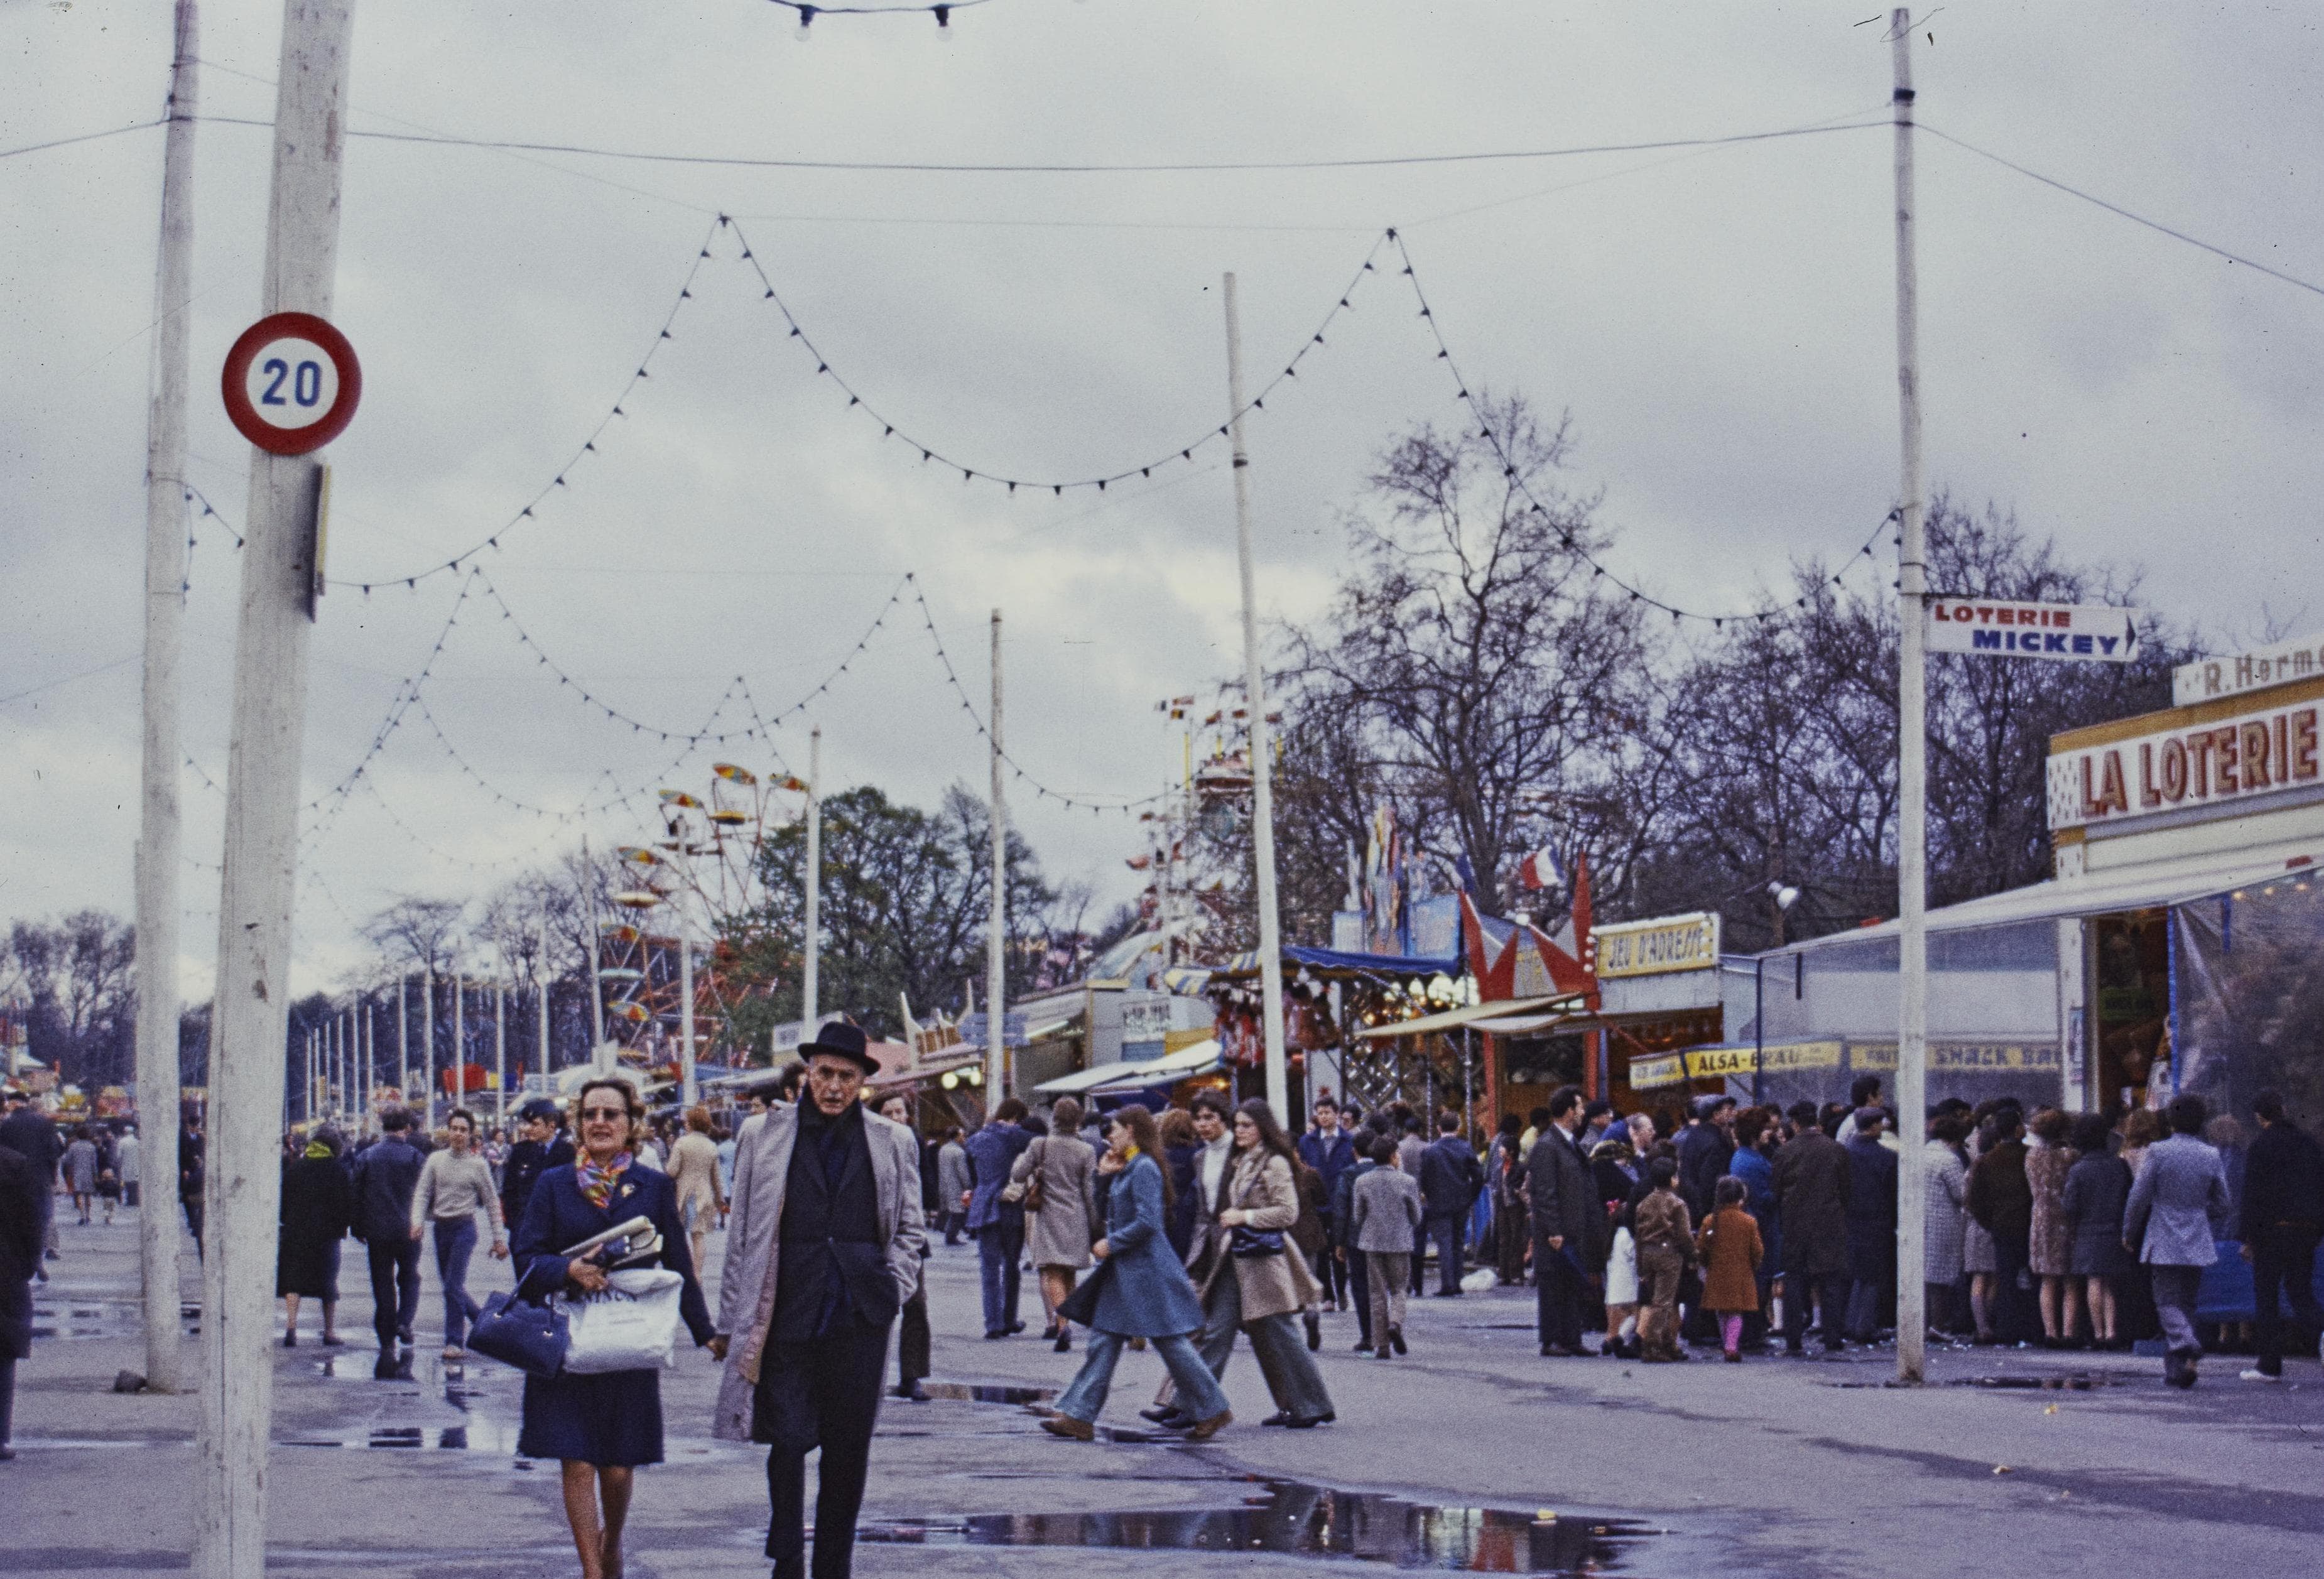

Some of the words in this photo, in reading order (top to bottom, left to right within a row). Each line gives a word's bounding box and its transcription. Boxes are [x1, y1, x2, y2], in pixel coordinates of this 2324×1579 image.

[262, 358, 322, 407] 20
[1935, 604, 2072, 627] LOTERIE
[1972, 629, 2119, 655] MICKEY
[2080, 749, 2128, 817] LA
[2139, 708, 2318, 806] LOTERIE
